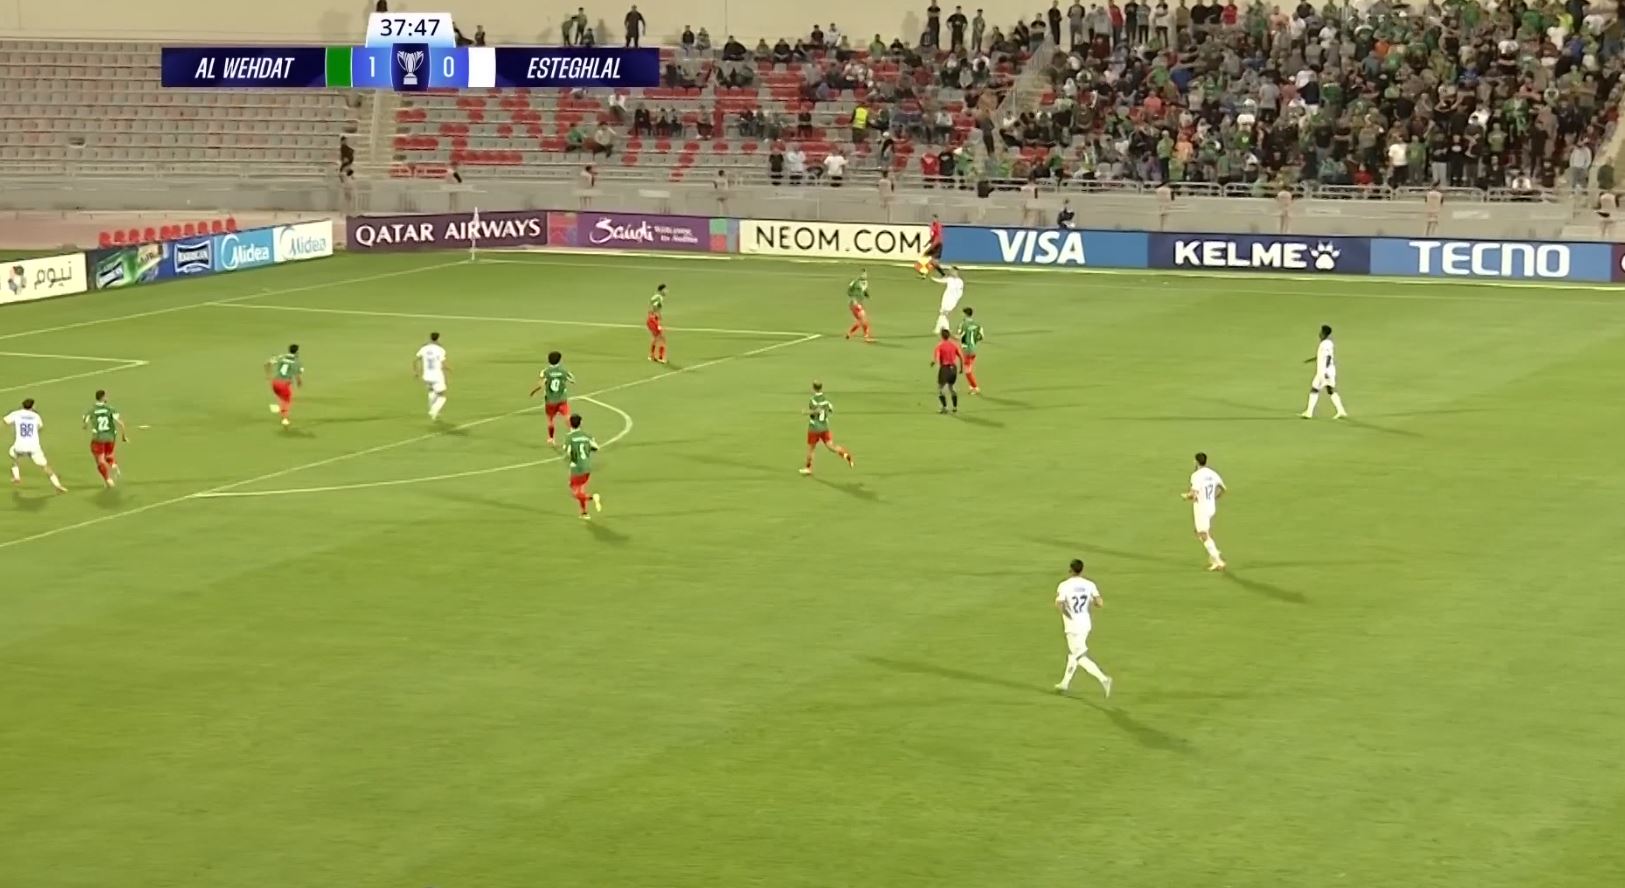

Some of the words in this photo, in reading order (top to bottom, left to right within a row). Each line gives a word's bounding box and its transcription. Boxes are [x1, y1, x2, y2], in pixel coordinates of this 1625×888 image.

[283, 231, 326, 257] Midea
[355, 223, 434, 246] QATAR
[444, 217, 541, 241] AIRWAYS
[589, 217, 653, 244] Saudi
[756, 226, 921, 253] NEOM.COM
[222, 237, 270, 269] Midea
[990, 229, 1086, 265] VISA
[1174, 240, 1308, 268] KELME
[1408, 240, 1570, 278] TECNO
[34, 261, 72, 290] نيوم
